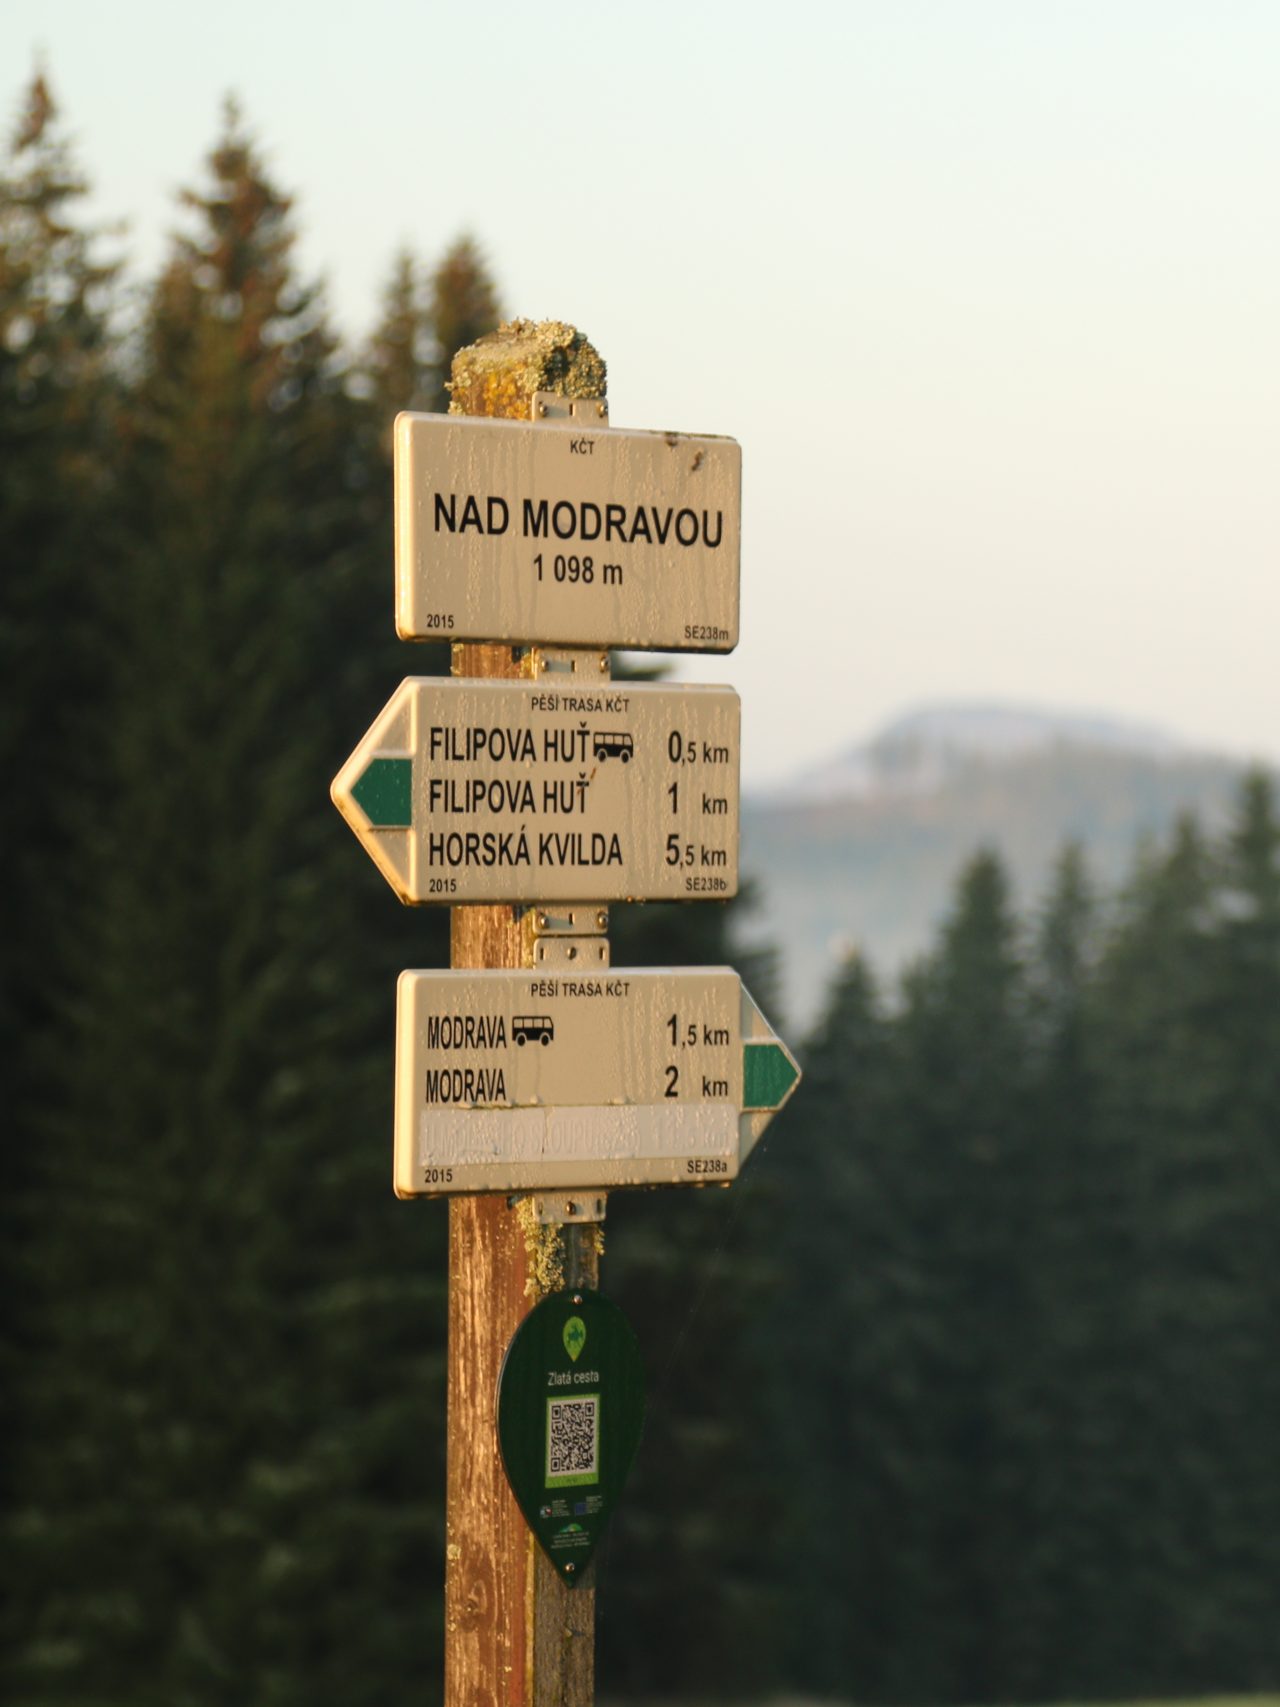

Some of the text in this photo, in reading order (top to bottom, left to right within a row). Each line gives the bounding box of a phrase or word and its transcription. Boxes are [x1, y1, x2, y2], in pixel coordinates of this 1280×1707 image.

[571, 438, 594, 454] KČT
[435, 493, 722, 548] NAD MODRAVOU
[534, 554, 622, 584] 1 098 m
[427, 614, 454, 628] 2015
[685, 626, 728, 640] SE238m
[562, 698, 602, 712] TRASA
[606, 696, 629, 712] KČT
[431, 722, 728, 765] FILIPOVA HUŤ 0,5 km
[430, 773, 727, 814] FILIPOVA HUŤ 1 km
[430, 825, 726, 868] HORSKÁ KVILDA 5,5 km
[430, 879, 456, 892] 2015
[562, 983, 602, 996] TRASA
[606, 981, 629, 996] KČT
[428, 1014, 729, 1049] MODRAVA 1,5 km
[426, 1066, 728, 1103] MODRAVA 2 km
[688, 1160, 727, 1173] SE238a
[425, 1169, 452, 1183] 2015
[547, 1370, 600, 1387] Zlatá cesta
